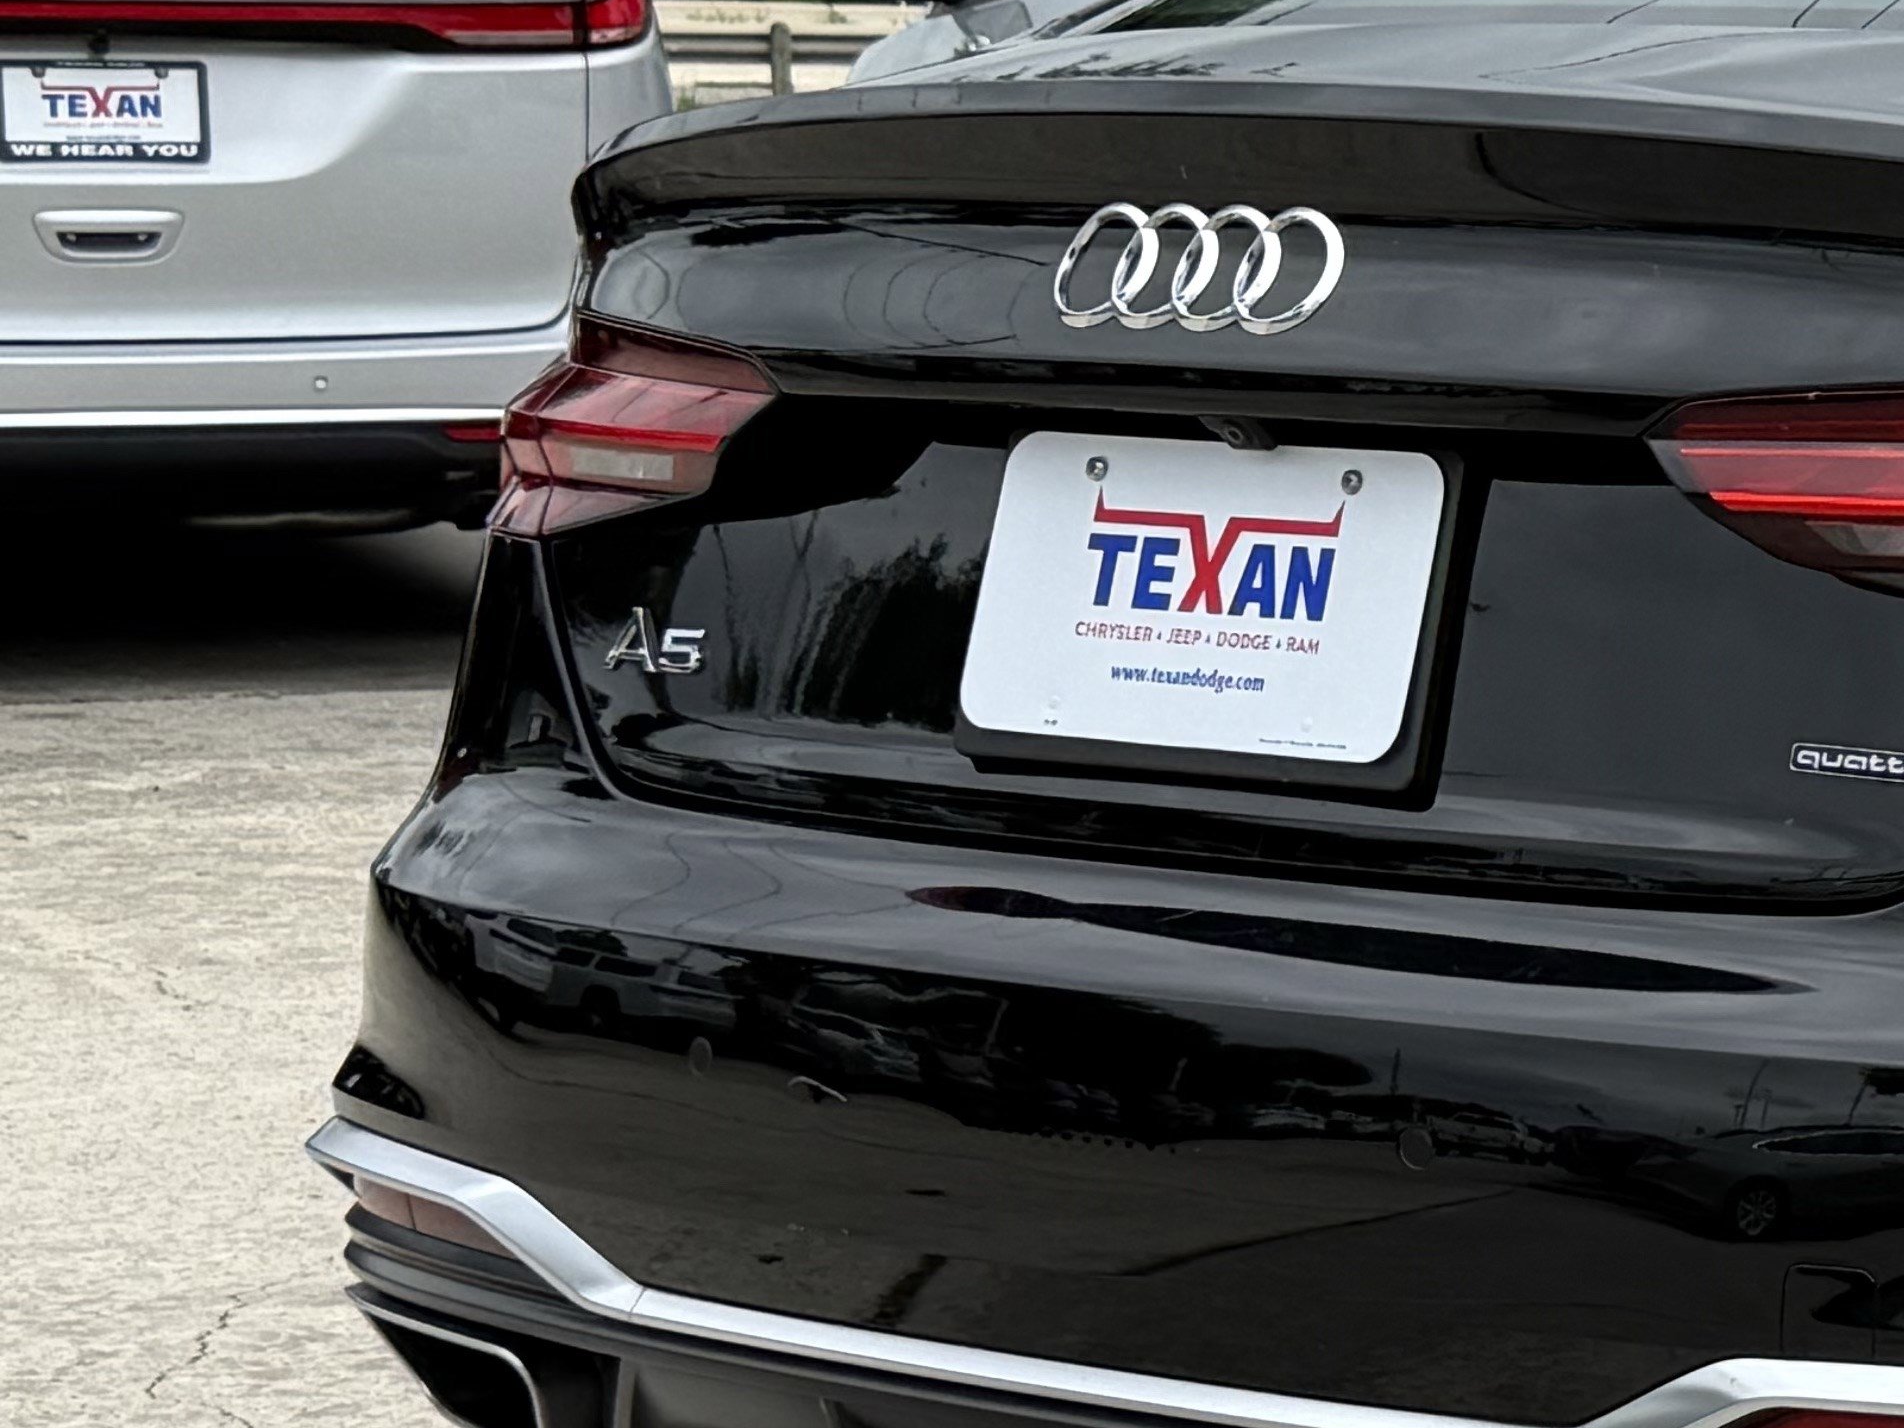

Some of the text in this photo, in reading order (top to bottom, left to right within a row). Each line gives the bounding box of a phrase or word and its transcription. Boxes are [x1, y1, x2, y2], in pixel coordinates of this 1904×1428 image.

[41, 86, 162, 118] TEXAN
[11, 144, 198, 157] WE HEAR YOU
[1088, 515, 1337, 622] TEXAN
[603, 607, 706, 674] A5
[1075, 621, 1320, 655] CHRYSLER JEEP DODGE RAM
[1111, 665, 1266, 693] www.texandodge.com
